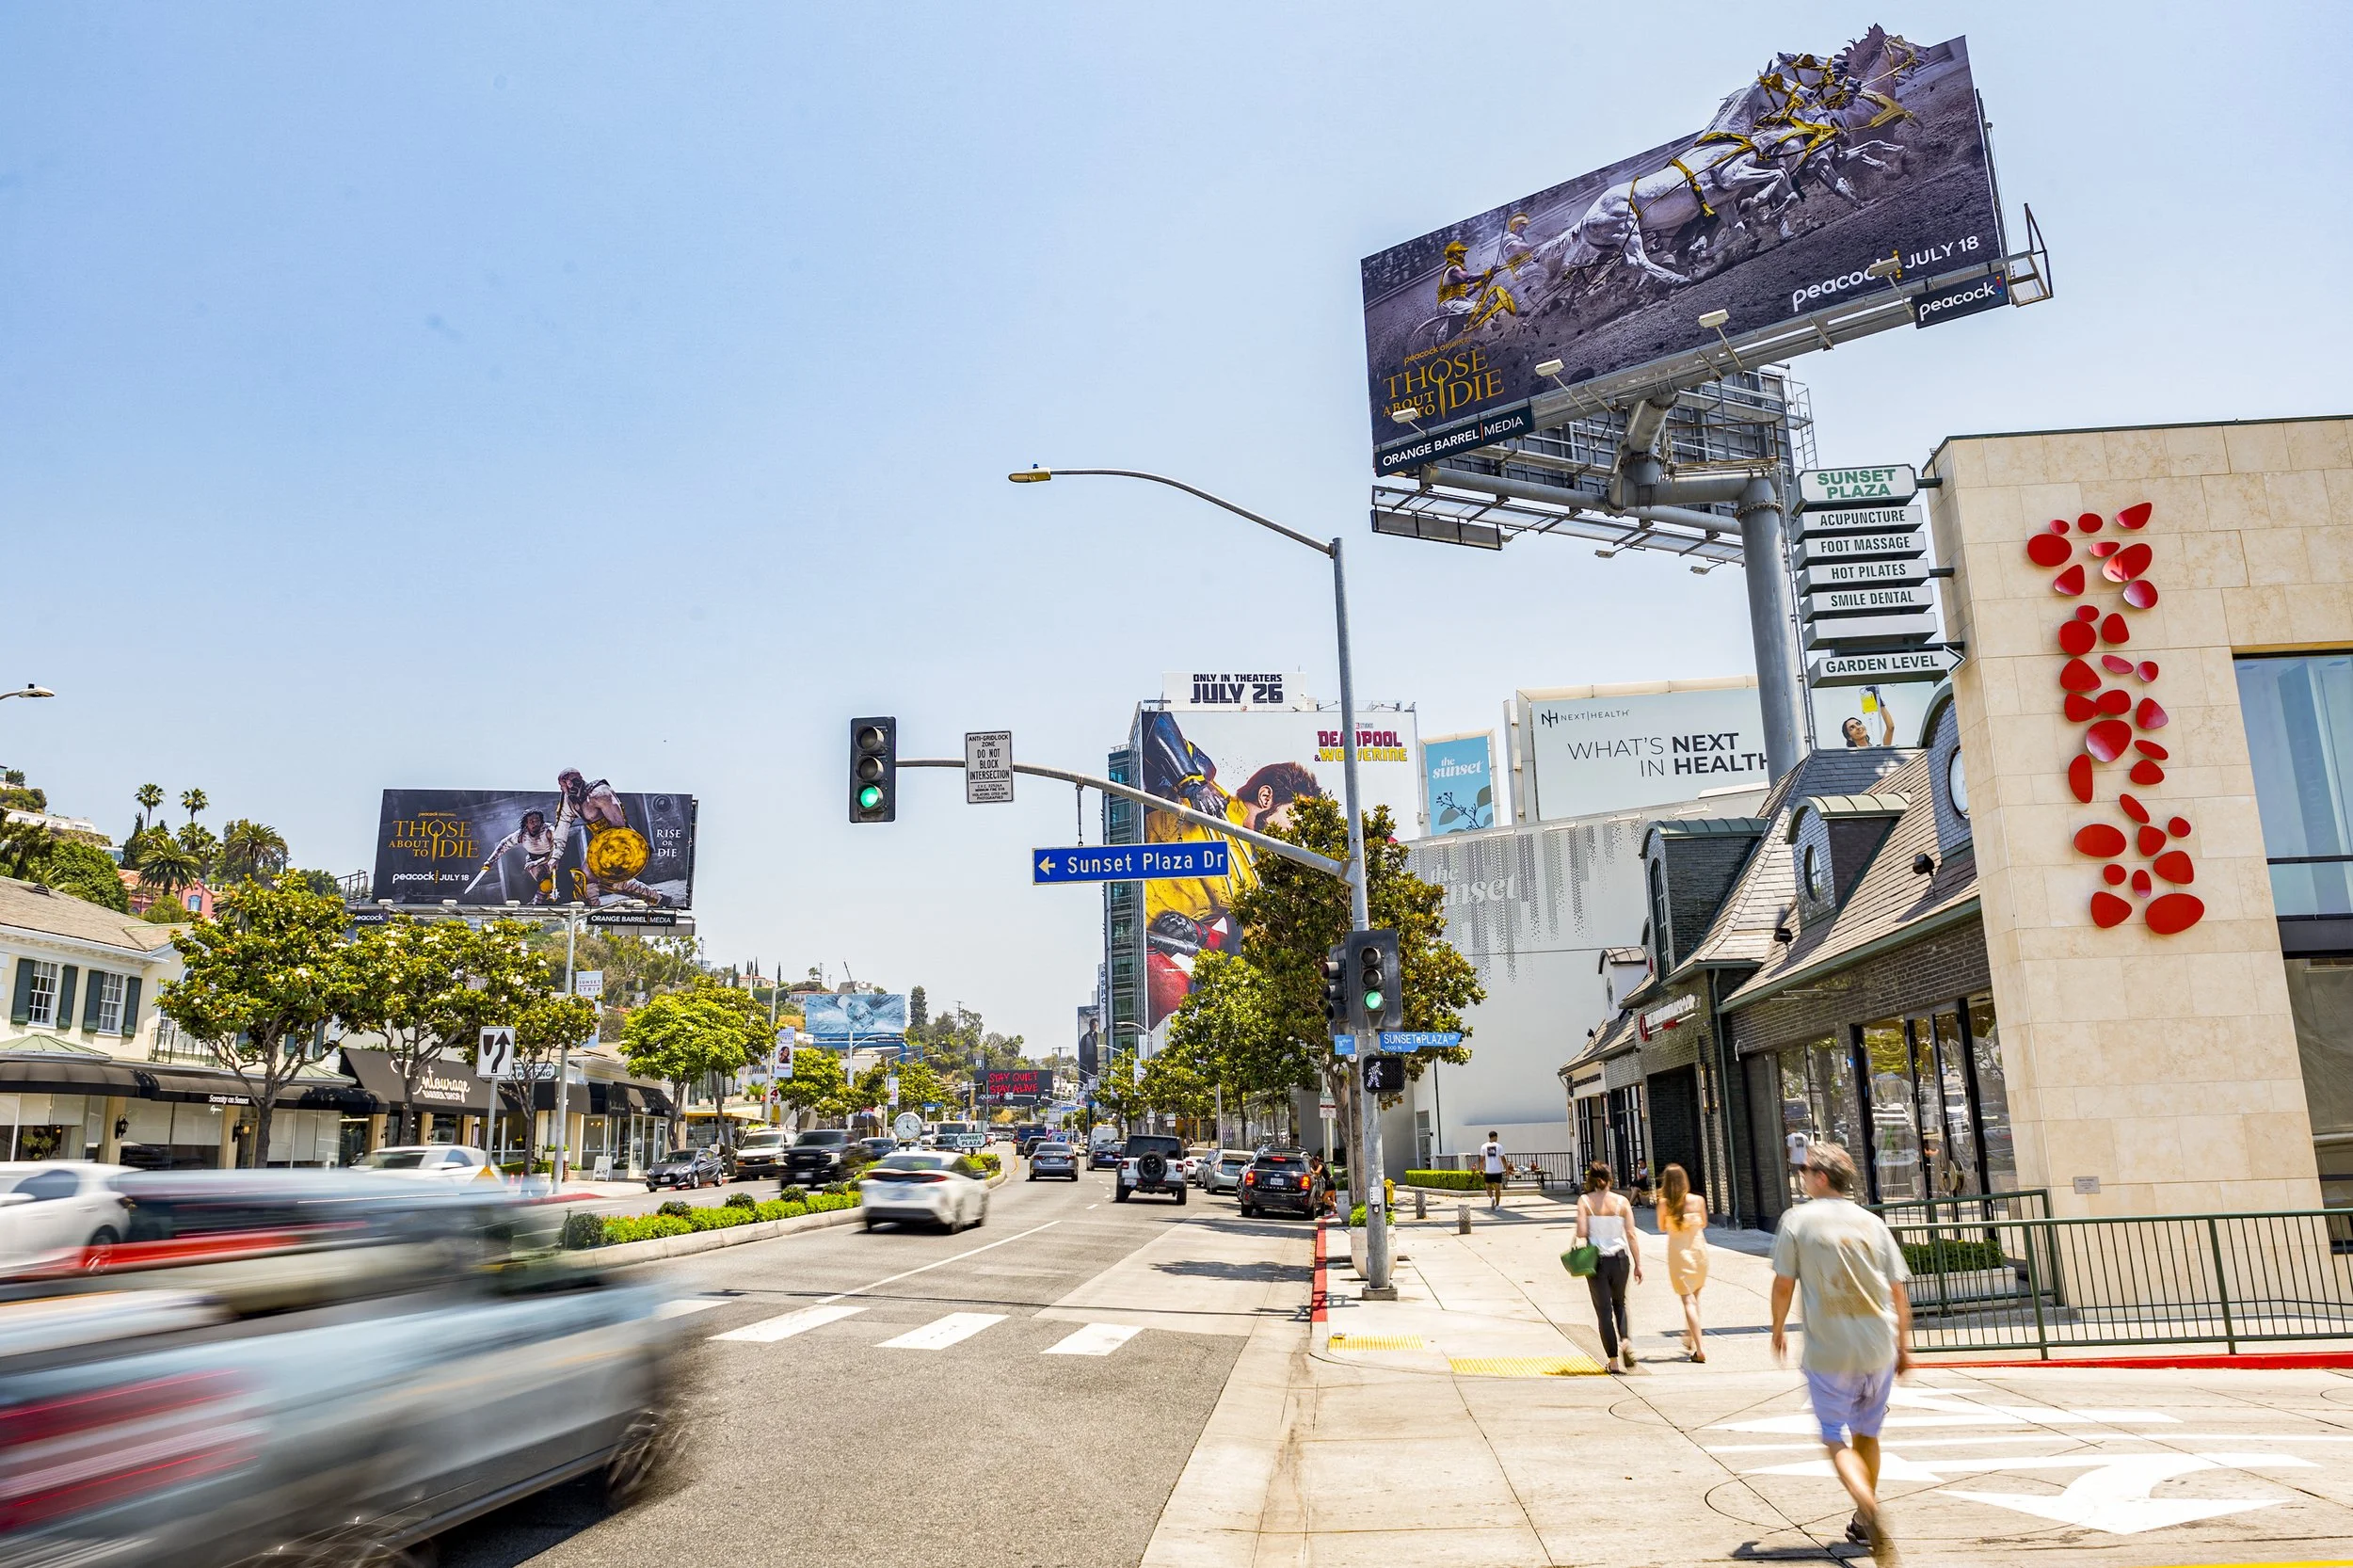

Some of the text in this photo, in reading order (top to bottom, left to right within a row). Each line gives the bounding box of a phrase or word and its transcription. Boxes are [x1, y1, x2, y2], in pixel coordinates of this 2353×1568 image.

[1792, 258, 1892, 312] peacoc
[1905, 242, 1954, 269] JULY
[1959, 235, 1979, 253] 18
[1919, 281, 1996, 321] peacock
[1403, 346, 1439, 366] peacock
[1383, 346, 1489, 400] THOSE
[1449, 368, 1505, 409] DIE
[1383, 391, 1435, 418] ABOUT
[1417, 404, 1436, 419] TO
[1383, 416, 1524, 467] ORANGE BARREL MEDIA
[1817, 469, 1897, 486] SUNSET
[1827, 483, 1892, 500] PLAZA
[1820, 509, 1906, 527] ACUPUNCTURE
[1820, 536, 1911, 553] FOOT MASSAGE
[1831, 563, 1907, 580] HOT PILATES
[1831, 590, 1914, 608] SMILE DENTAL
[1826, 654, 1939, 674] GARDEN LEVEL
[1193, 674, 1283, 682] ONLY IN THEATERS
[1190, 683, 1284, 704] JULY 26
[977, 748, 1000, 759] DO NOT
[1319, 747, 1408, 762] WOERINE
[1567, 732, 1739, 760] WHAT'S NEXT
[980, 760, 999, 769] BLOCK
[1433, 760, 1484, 779] sunset
[1441, 757, 1456, 767] the
[1641, 759, 1665, 777] IN
[969, 770, 1009, 780] INTERSECTION
[392, 819, 472, 838] THOSE
[656, 829, 681, 839] RISE
[389, 840, 429, 848] ABOUT
[413, 849, 429, 857] TO
[439, 840, 480, 858] DIE
[658, 848, 678, 857] DIE
[1066, 850, 1225, 874] Sunset Plaza Dr
[392, 871, 435, 884] peacock
[1431, 865, 1459, 884] the
[1441, 872, 1519, 905] nset
[1384, 1033, 1417, 1045] SUNSET
[1421, 1034, 1449, 1045] PLAZA
[412, 1065, 471, 1104] ntourage
[989, 1070, 1038, 1082] STAY QUIET
[989, 1083, 1038, 1094] STAY ALIVE
